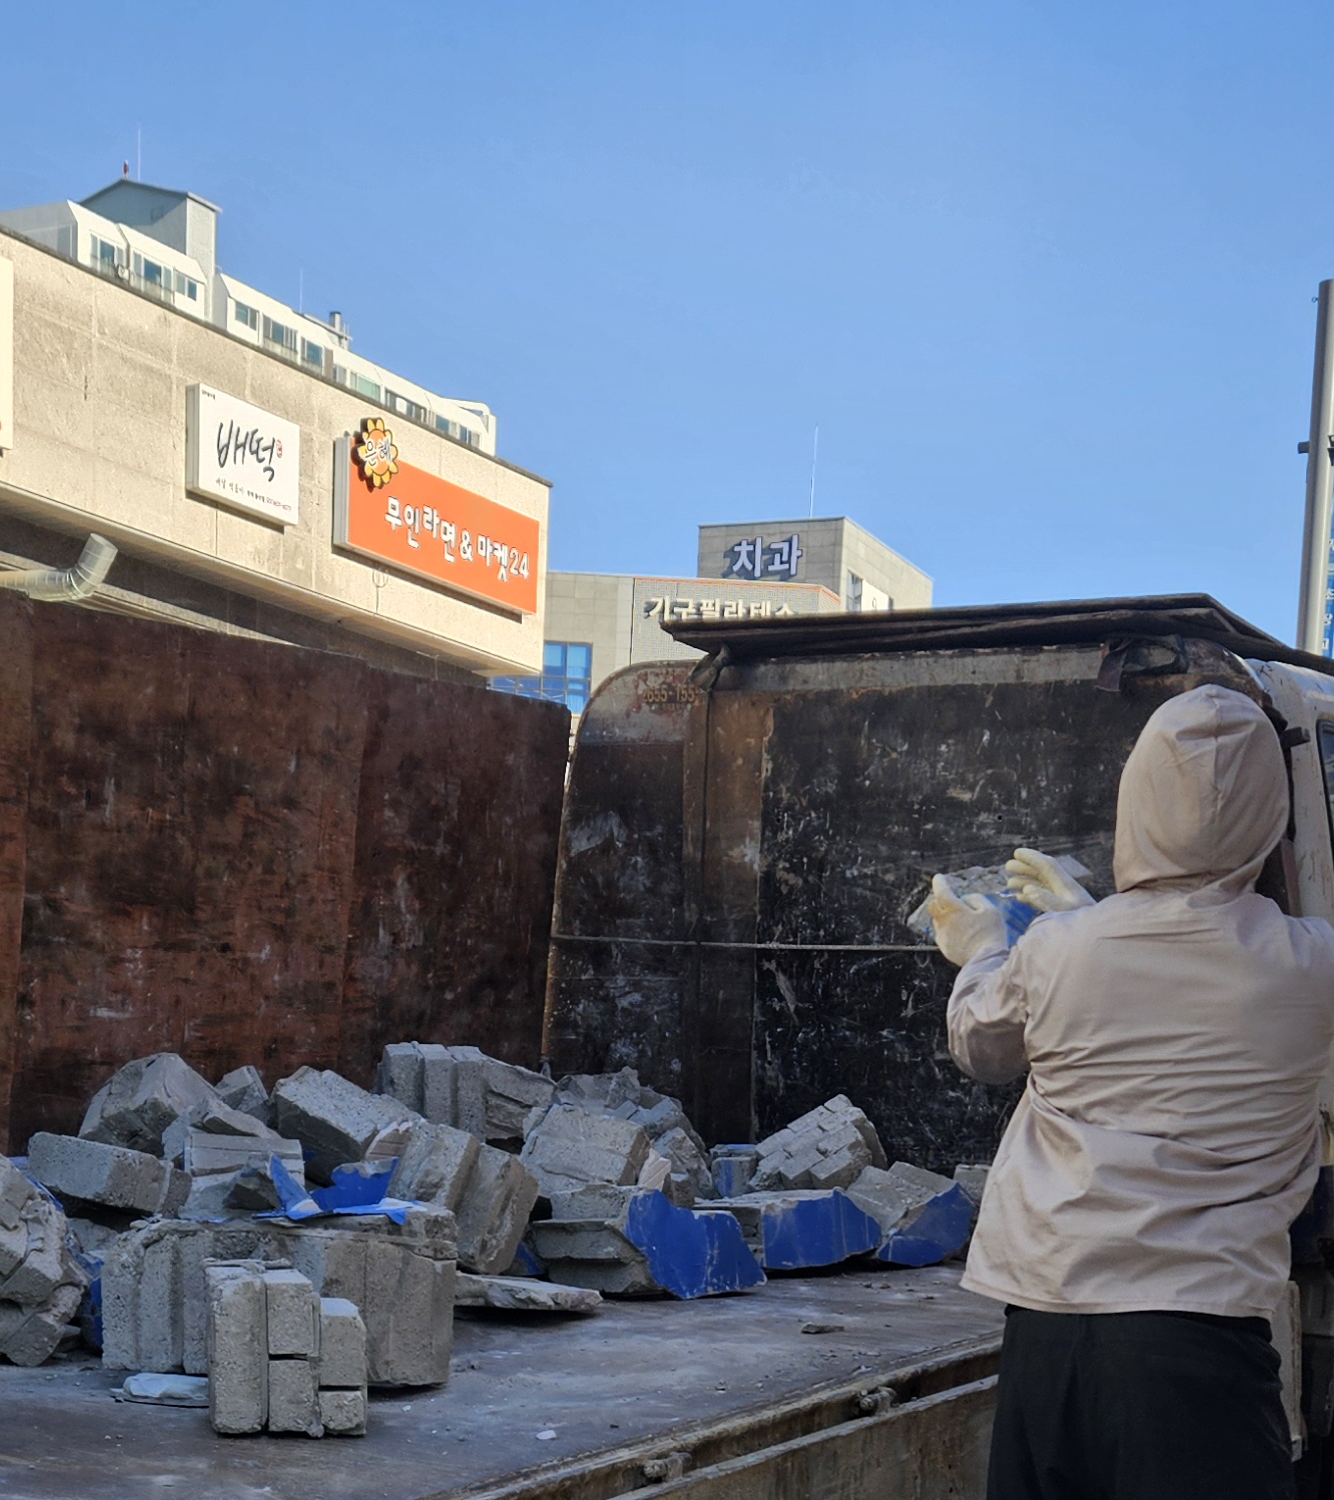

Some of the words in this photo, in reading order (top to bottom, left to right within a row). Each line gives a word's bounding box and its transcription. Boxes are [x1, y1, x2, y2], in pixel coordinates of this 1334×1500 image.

[217, 419, 276, 482] 배떡
[364, 437, 392, 467] 은혜
[385, 496, 457, 563] 무인라면
[460, 528, 473, 562] &
[732, 534, 803, 577] 치과
